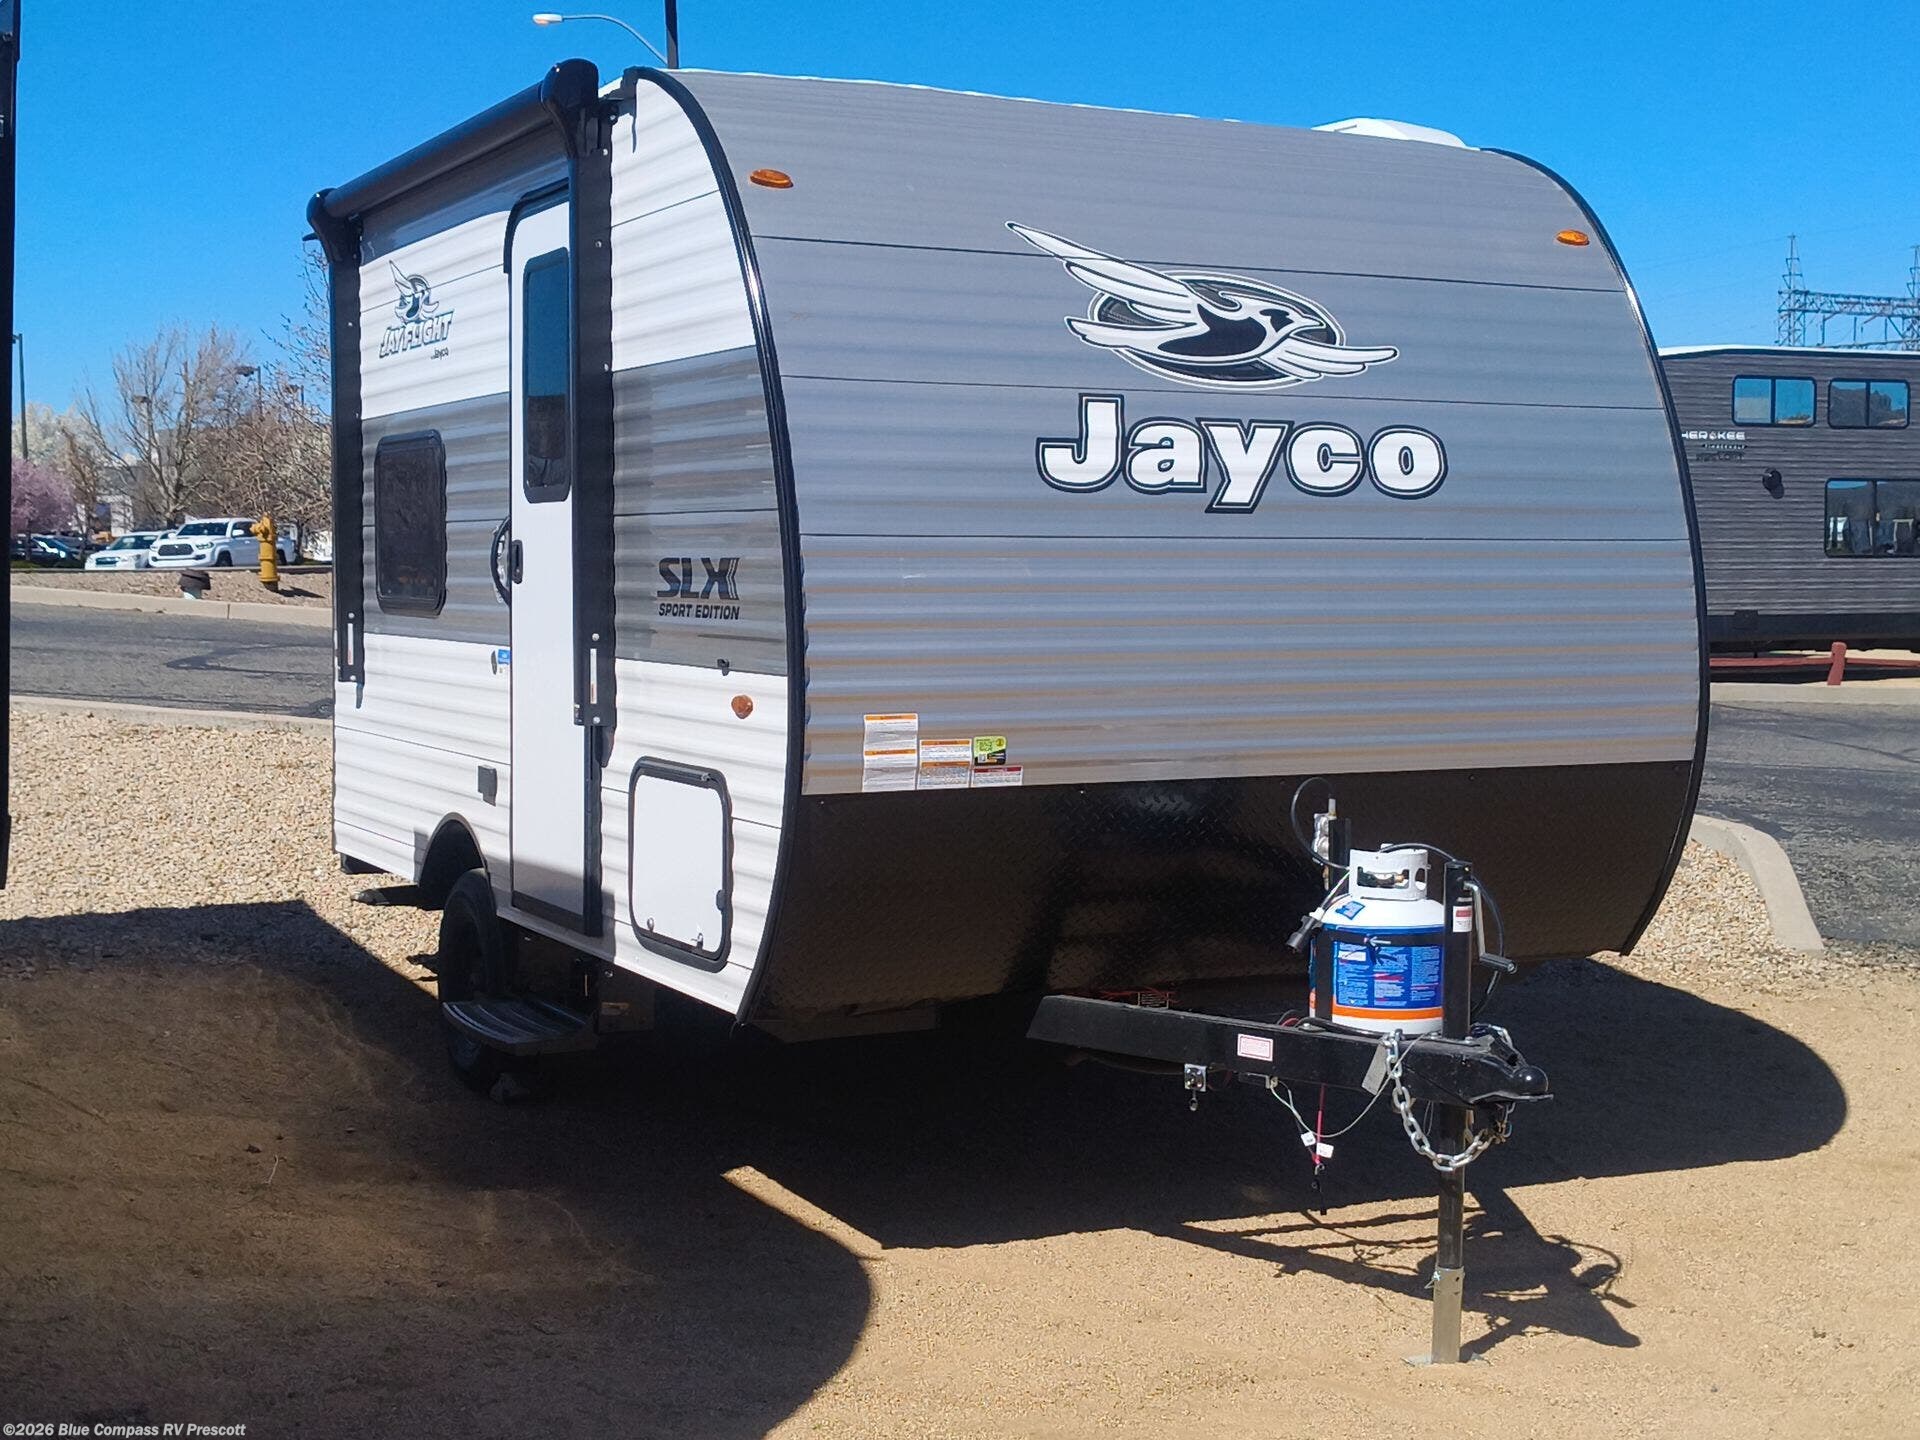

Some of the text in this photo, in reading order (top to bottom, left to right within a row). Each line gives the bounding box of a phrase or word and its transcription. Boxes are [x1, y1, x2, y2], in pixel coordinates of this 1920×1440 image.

[1681, 431, 1746, 440] HEROKEE
[1036, 393, 1448, 514] Jayco
[657, 557, 739, 600] SLX
[658, 603, 740, 620] SPORT EDITION
